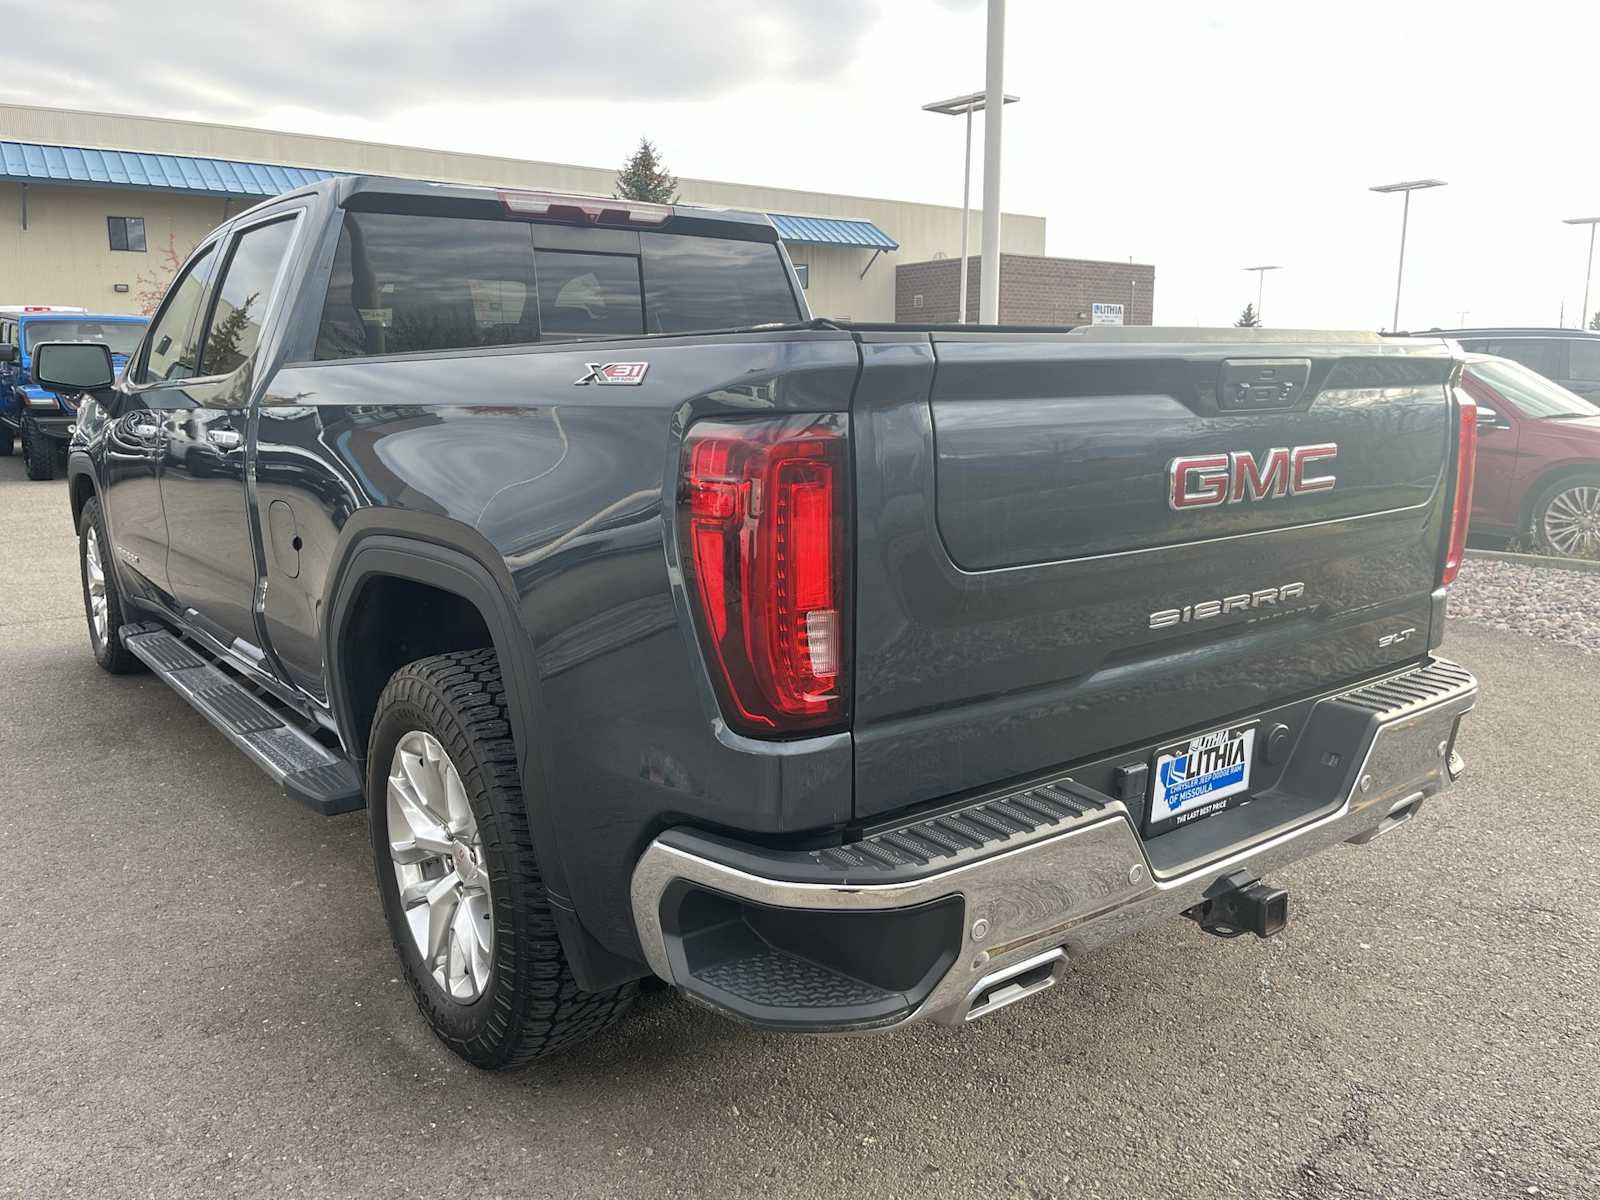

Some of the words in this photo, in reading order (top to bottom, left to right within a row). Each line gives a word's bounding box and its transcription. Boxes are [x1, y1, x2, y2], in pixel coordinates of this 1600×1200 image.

[1100, 304, 1122, 315] LITHIA
[574, 362, 648, 386] X31
[1169, 443, 1337, 511] GMC
[1149, 582, 1304, 629] SIERRA
[1378, 628, 1416, 648] SLT
[1185, 738, 1245, 780] LITHIA
[1170, 780, 1199, 794] CHRYSLER
[1199, 775, 1212, 785] JEEP
[1212, 768, 1231, 780] DODGE
[1169, 793, 1179, 805] OF
[1180, 782, 1213, 801] MISSOULA
[1176, 815, 1187, 824] THE
[1187, 810, 1200, 820] LAST
[1200, 805, 1212, 816] BEST
[1212, 800, 1227, 811] PRICE
